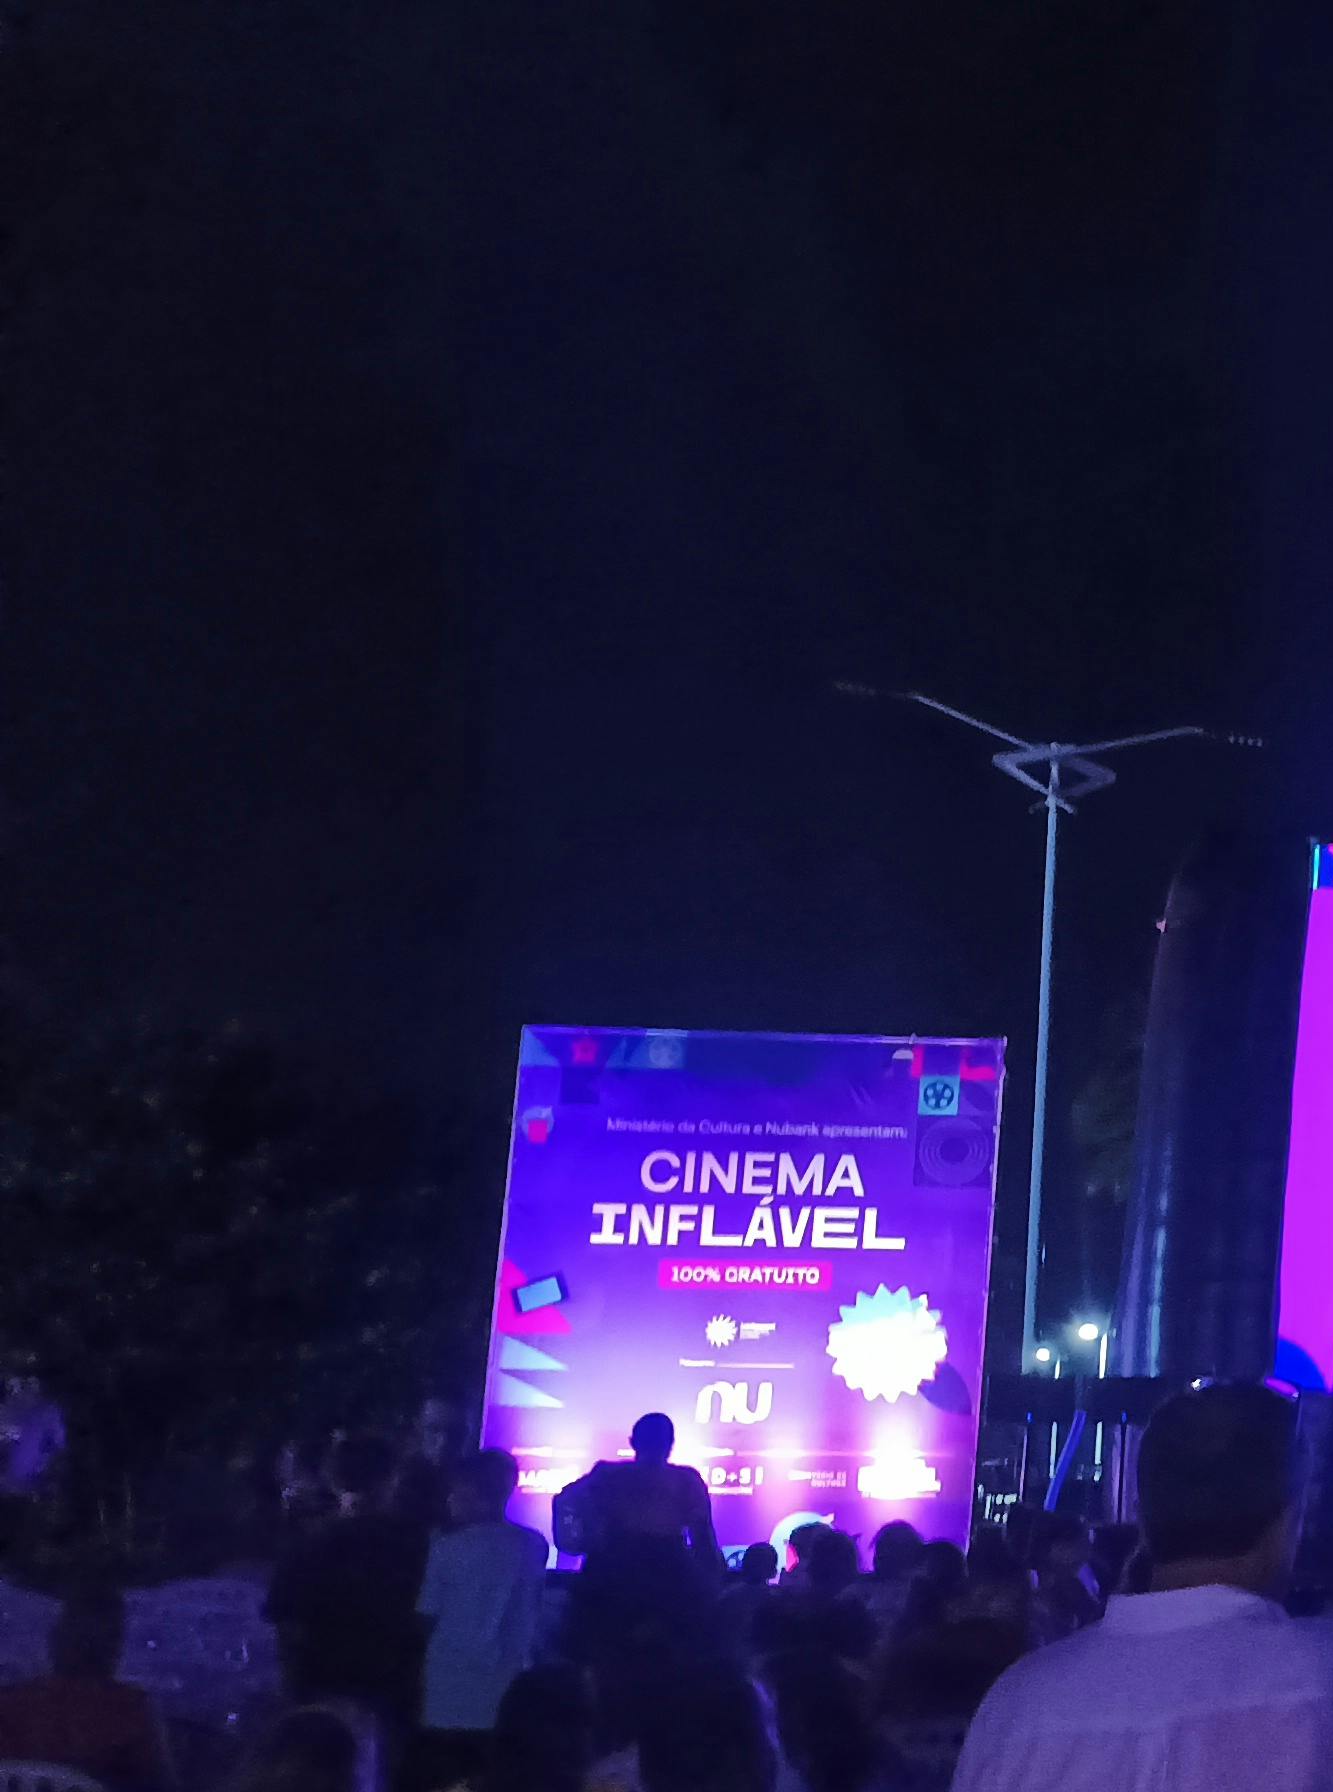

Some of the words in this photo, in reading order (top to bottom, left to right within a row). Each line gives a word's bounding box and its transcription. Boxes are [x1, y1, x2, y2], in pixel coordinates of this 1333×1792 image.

[677, 1120, 695, 1134] da
[699, 1119, 751, 1136] Cultura
[753, 1124, 763, 1136] e
[765, 1120, 819, 1137] Nubank
[640, 1150, 865, 1198] CINEMA
[589, 1194, 906, 1250] INFLÁVEL
[671, 1265, 721, 1284] 100%
[725, 1266, 820, 1285] GRATUITO
